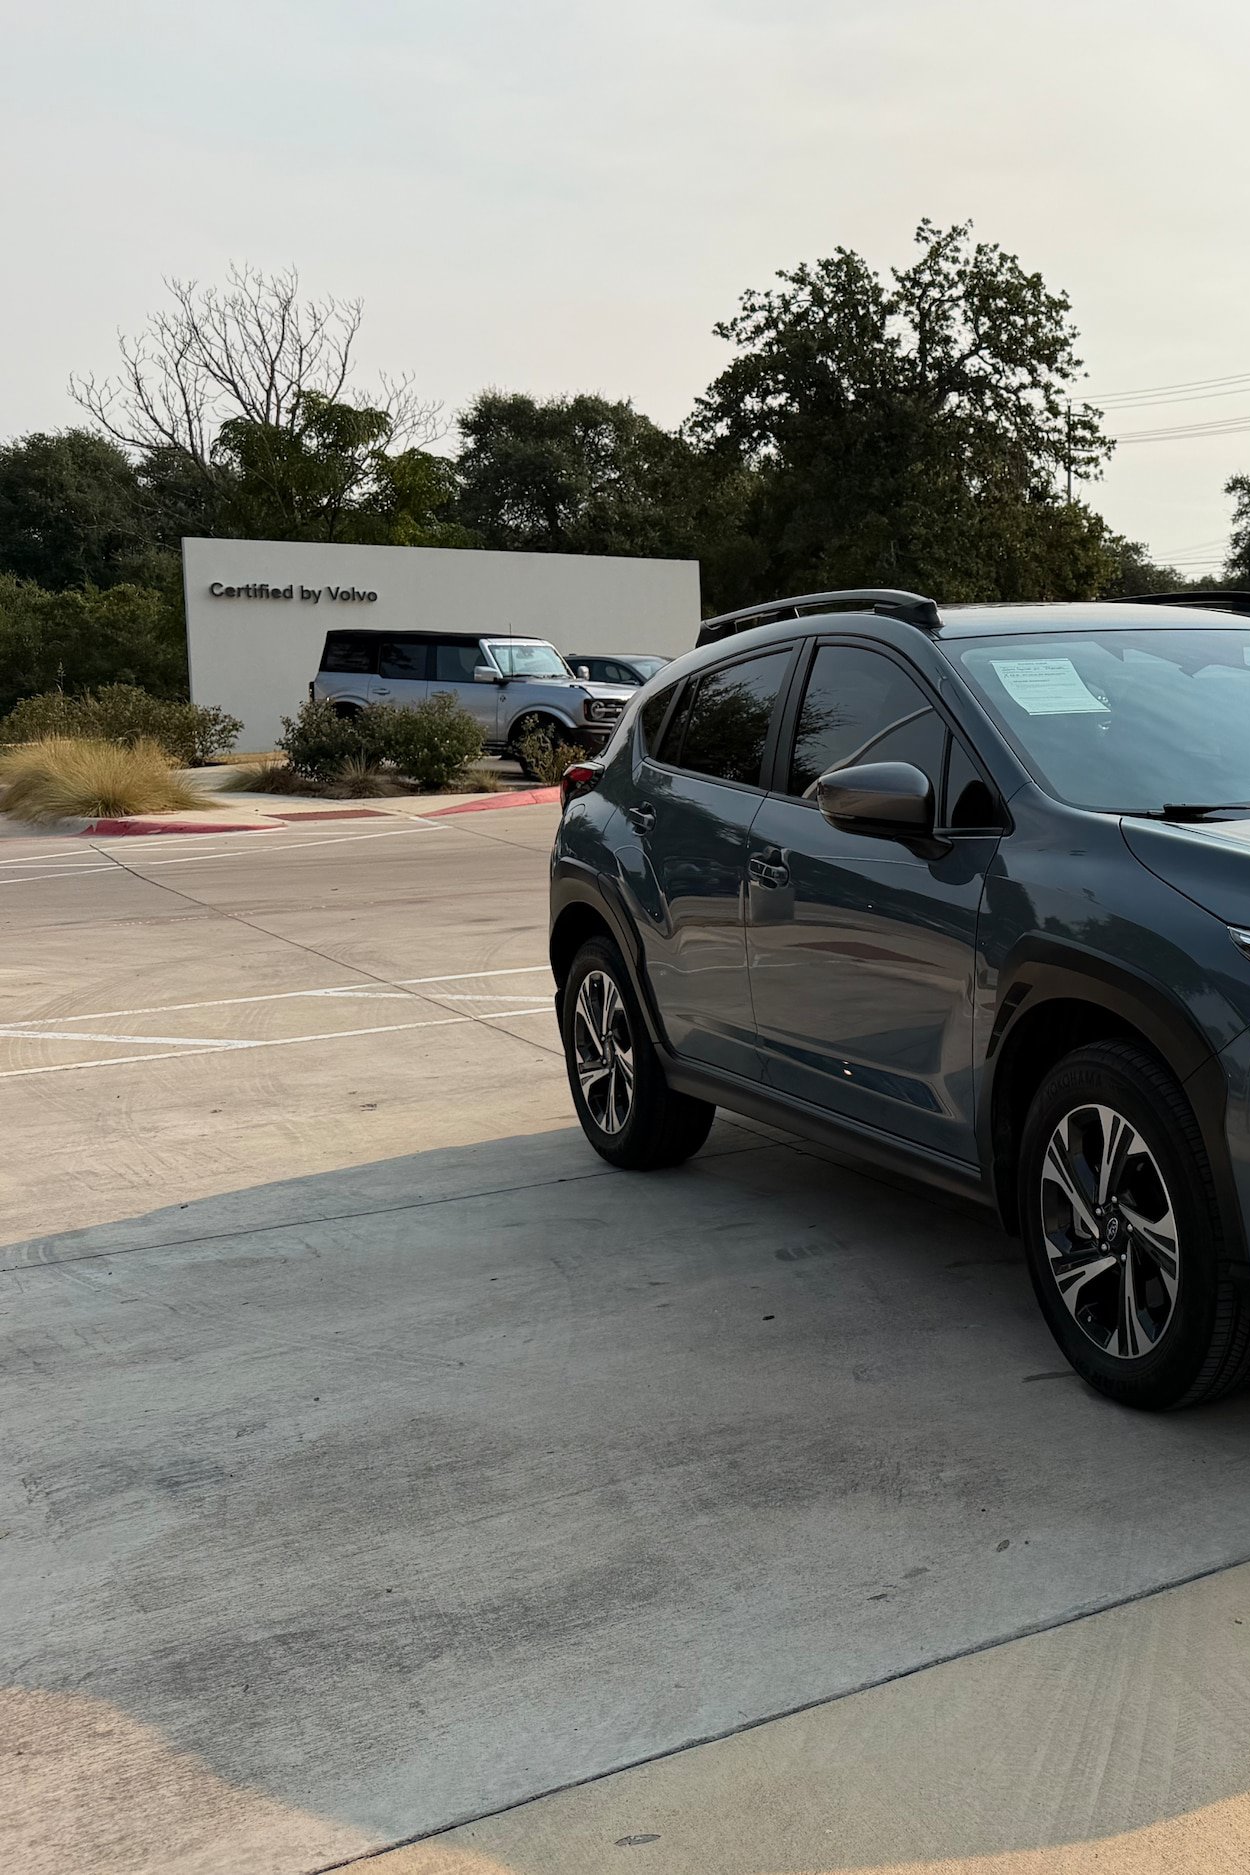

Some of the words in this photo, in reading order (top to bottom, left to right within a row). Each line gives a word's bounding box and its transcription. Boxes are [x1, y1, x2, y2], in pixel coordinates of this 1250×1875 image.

[209, 582, 294, 599] Certified
[300, 585, 322, 604] by
[327, 586, 378, 602] Volvo
[1045, 1071, 1102, 1098] YOKOHAMA
